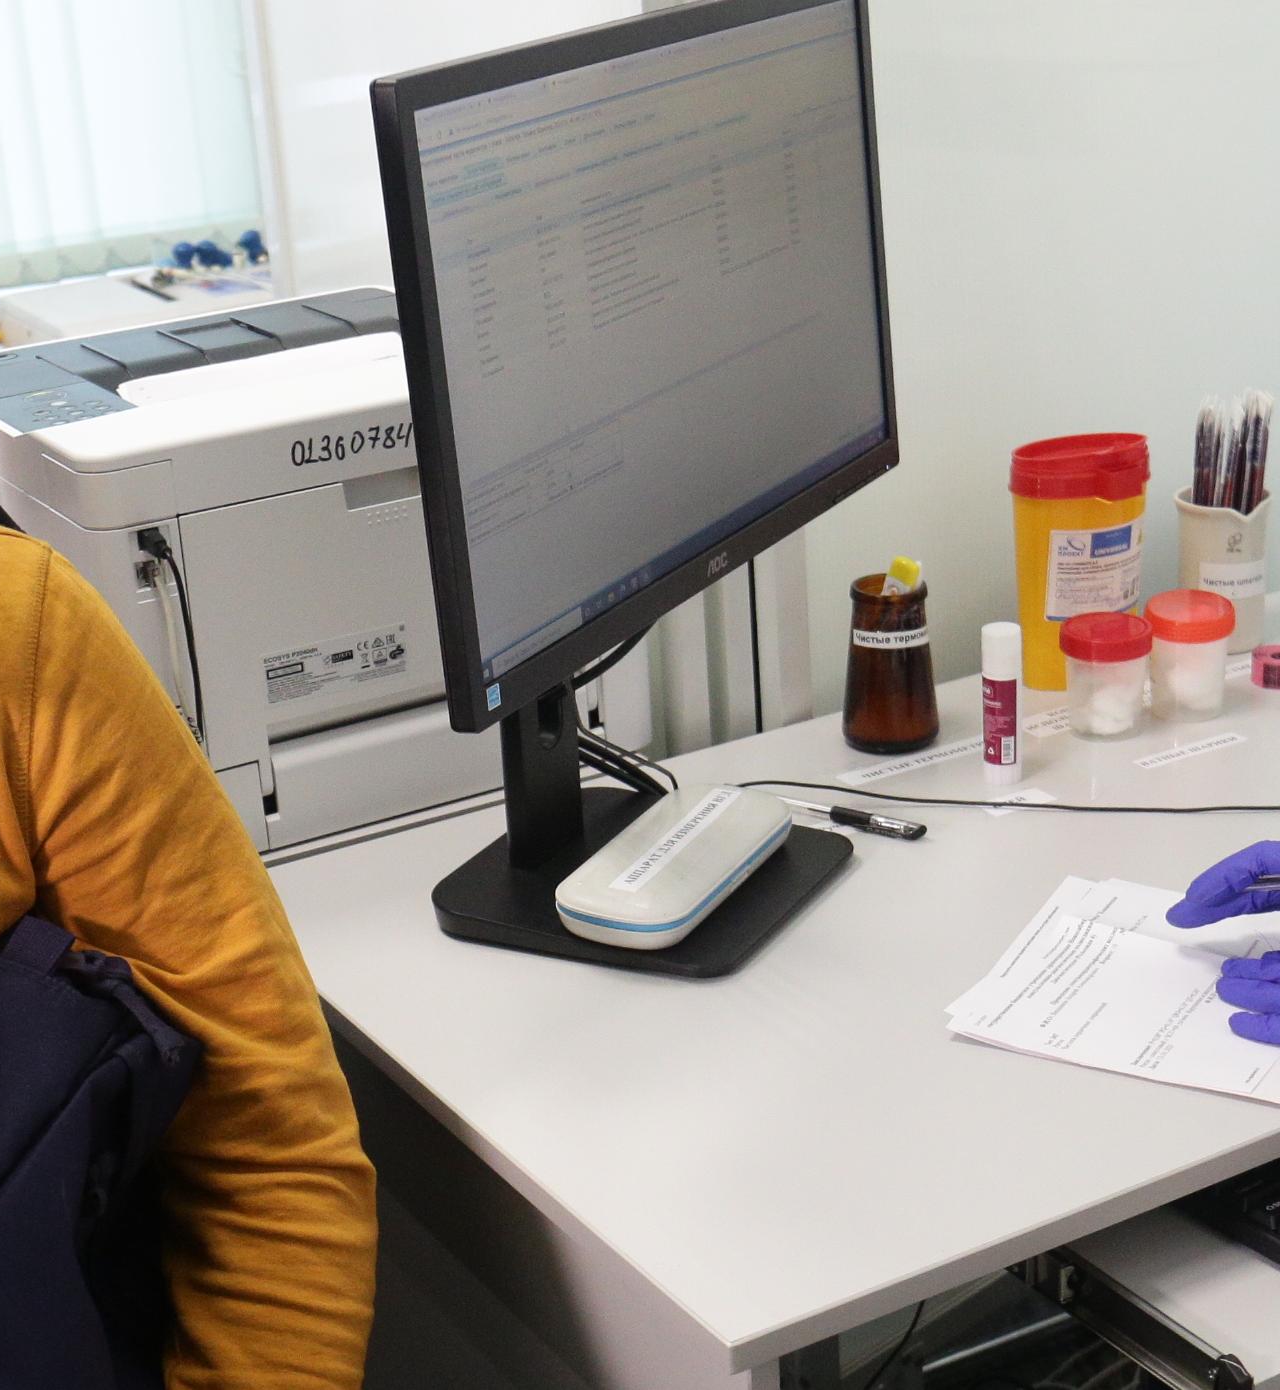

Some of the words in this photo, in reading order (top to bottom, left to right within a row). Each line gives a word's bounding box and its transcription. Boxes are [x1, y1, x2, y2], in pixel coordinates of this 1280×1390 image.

[291, 422, 414, 466] 01360784
[707, 551, 728, 577] AOC
[855, 632, 891, 645] Чистые
[624, 852, 663, 885] АППАРАТ
